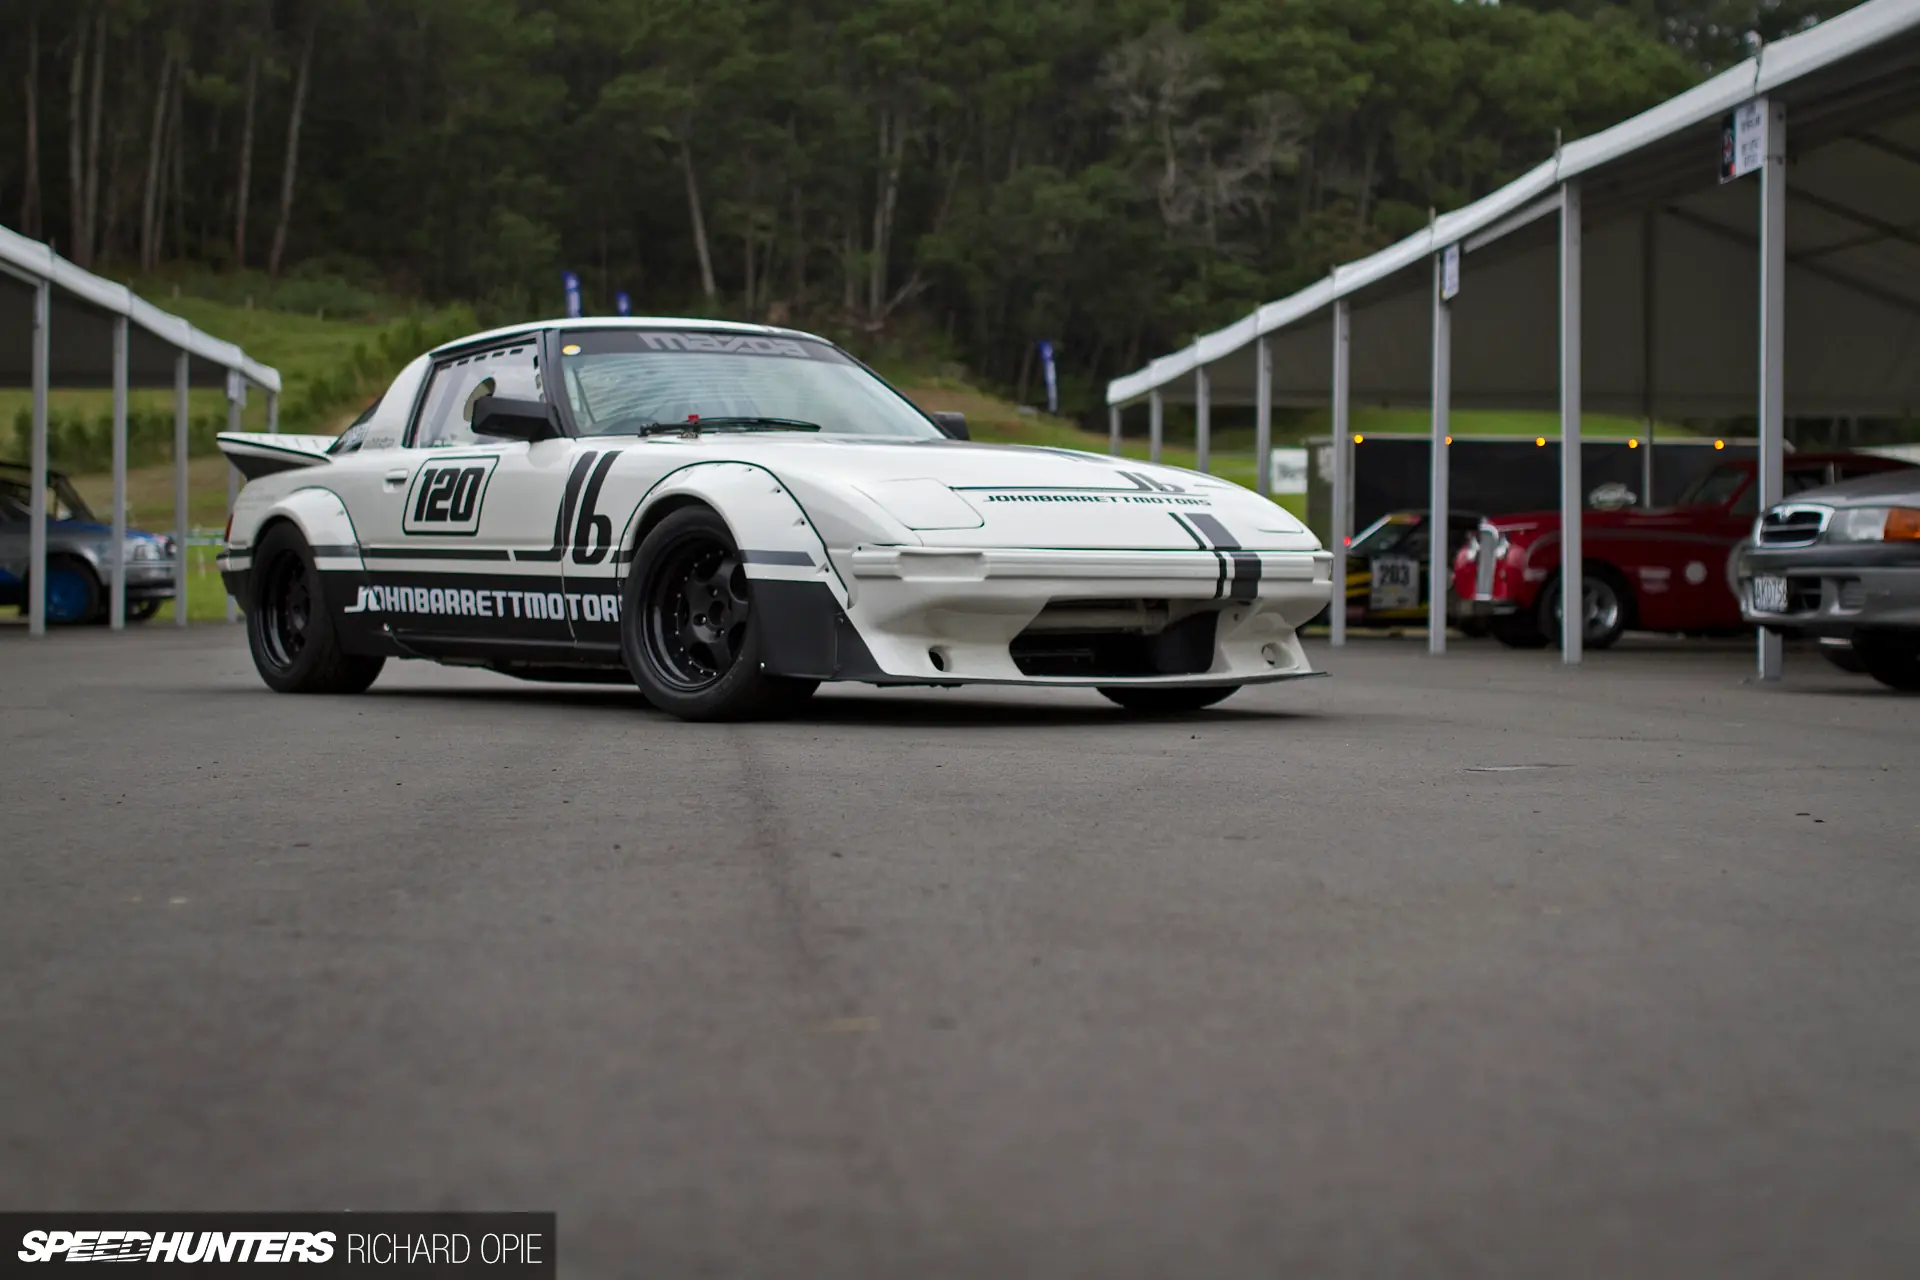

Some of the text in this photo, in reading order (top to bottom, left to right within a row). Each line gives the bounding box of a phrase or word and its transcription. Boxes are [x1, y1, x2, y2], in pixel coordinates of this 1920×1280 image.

[413, 467, 486, 522] 120
[983, 494, 1212, 507] JOHNBARRETTMOTORS
[344, 584, 623, 623] JOHNBARRETTMOTOR
